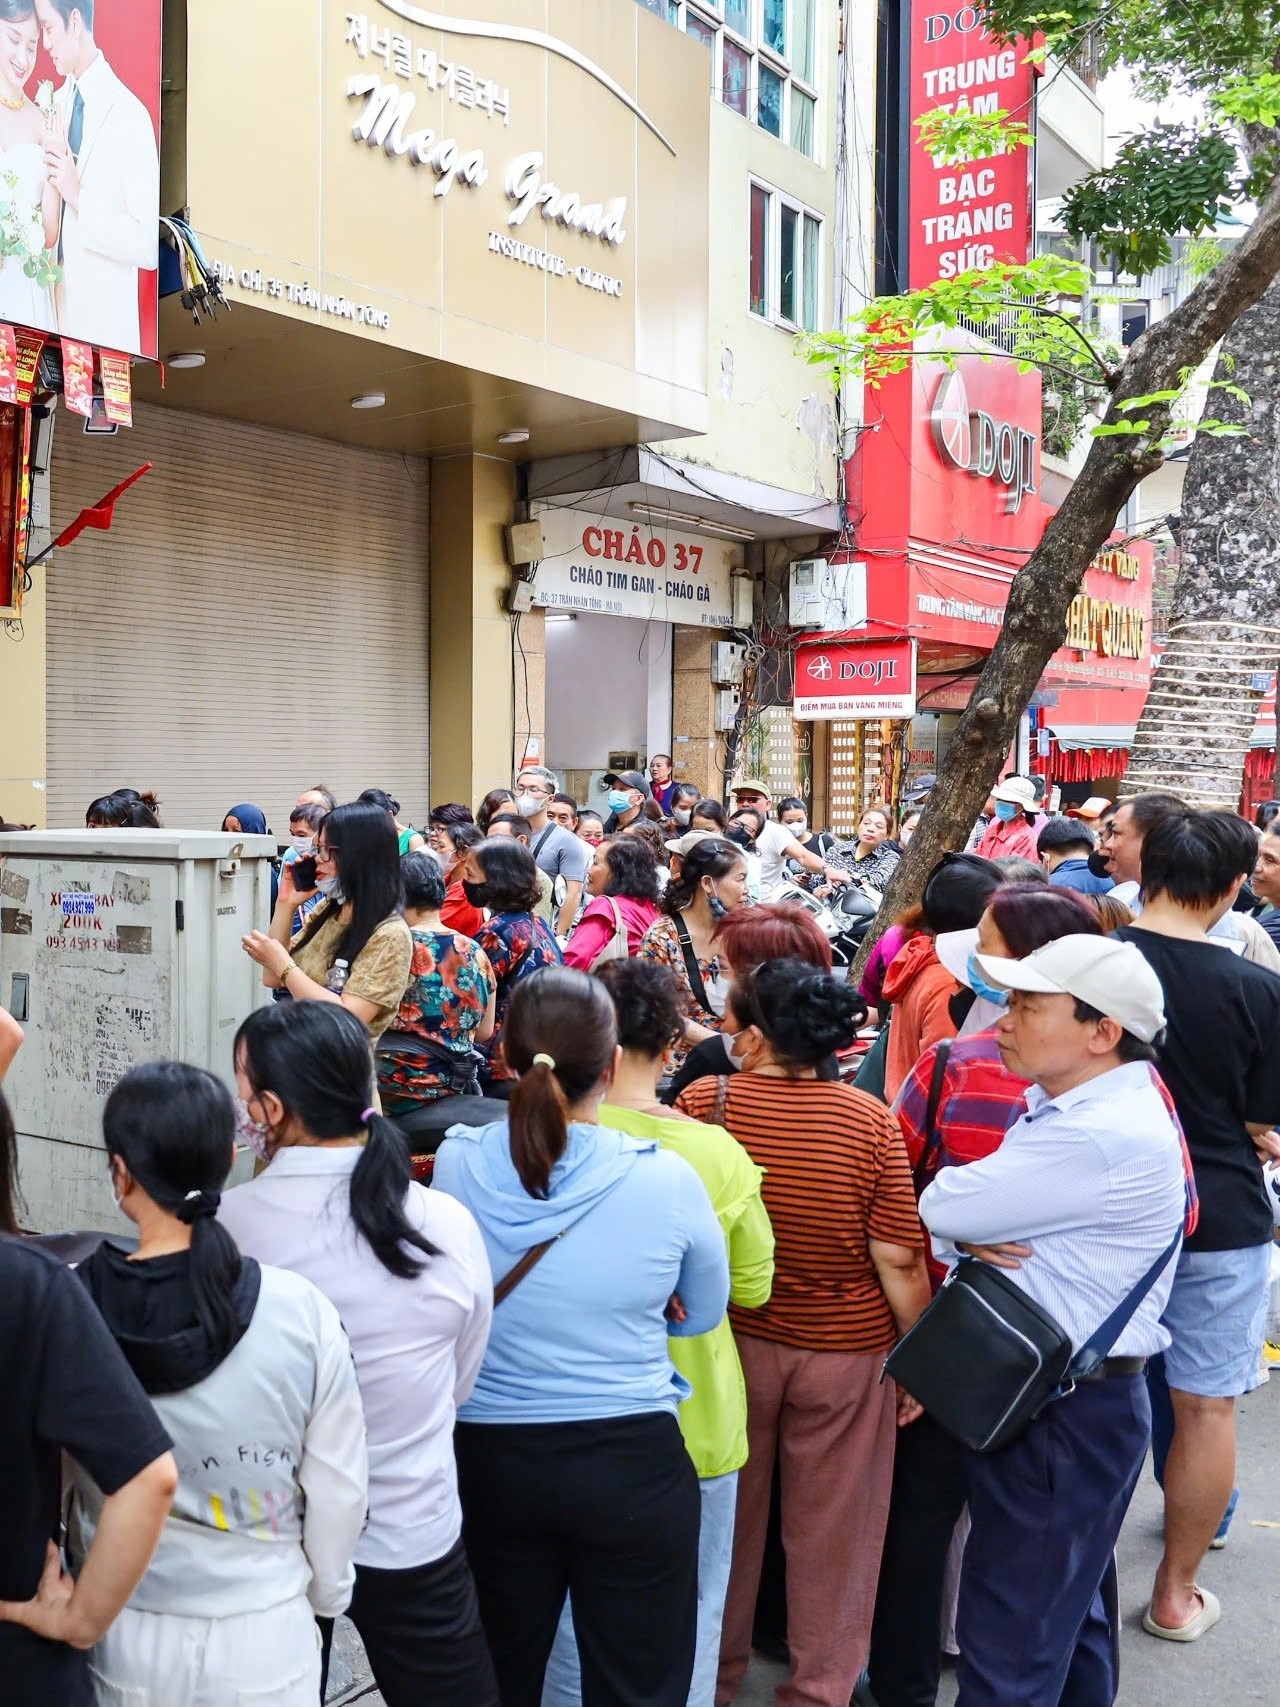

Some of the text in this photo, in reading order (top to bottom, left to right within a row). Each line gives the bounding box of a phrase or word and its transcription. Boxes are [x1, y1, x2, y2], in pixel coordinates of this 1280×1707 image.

[924, 5, 993, 43] DOJ
[922, 51, 1016, 99] TRUNG
[345, 72, 627, 247] Mega Grand
[938, 167, 996, 208] BẠC
[922, 202, 1013, 245] TRANG
[488, 231, 624, 299] INSTITUTE CLINIC
[938, 243, 994, 279] SỨC
[267, 278, 284, 298] 35
[286, 281, 321, 313] TRẦN
[322, 296, 355, 320] NHÂN
[357, 302, 391, 330] TÔNG
[977, 411, 1037, 515] DOJI
[673, 543, 704, 575] 37
[570, 565, 712, 603] CHÁO TIM GAN CHÁO GÀ
[1102, 600, 1145, 660] QUANG
[838, 660, 898, 686] DOJI
[820, 702, 837, 711] MUA
